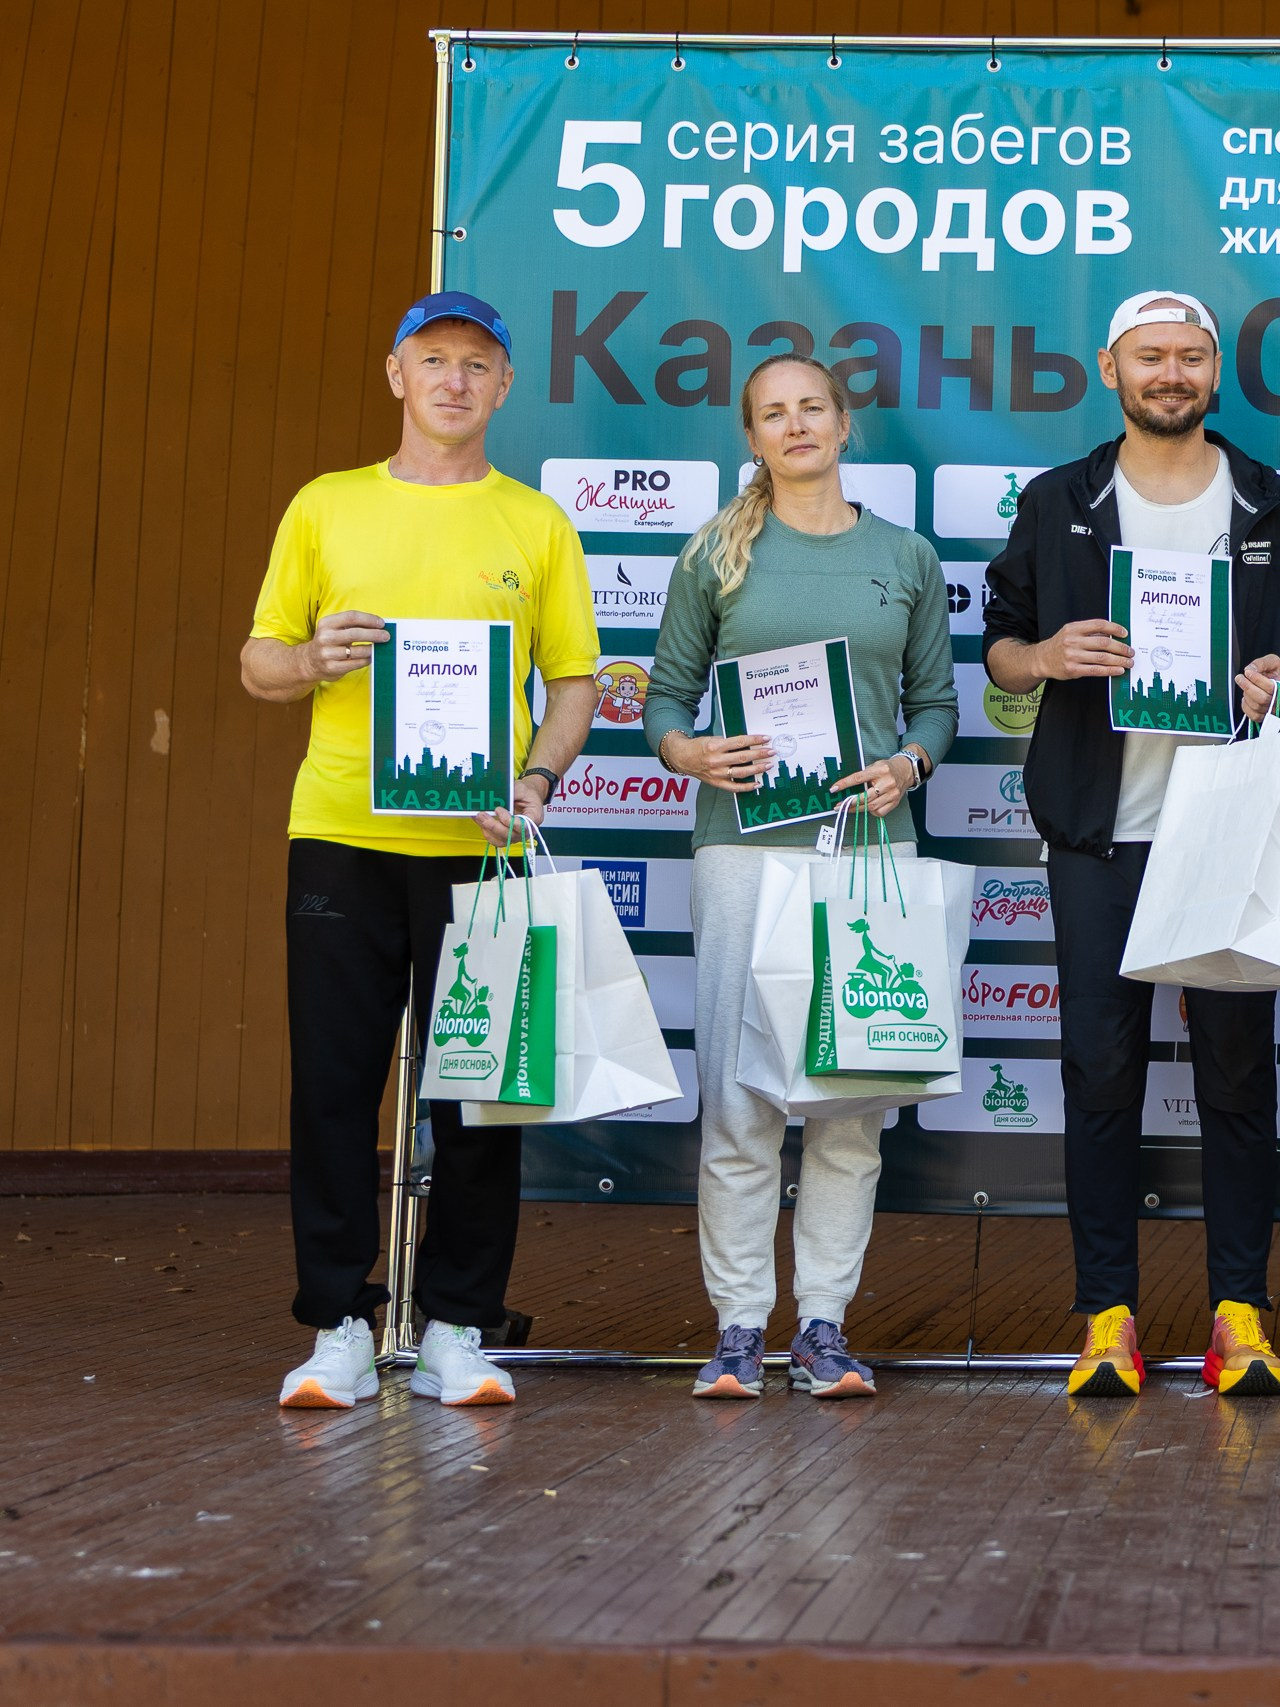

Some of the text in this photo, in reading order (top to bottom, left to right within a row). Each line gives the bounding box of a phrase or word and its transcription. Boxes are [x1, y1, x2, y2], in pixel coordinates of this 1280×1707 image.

[667, 112, 1132, 173] серия забегов
[552, 120, 646, 248] 5
[663, 183, 1133, 273] городов
[613, 469, 671, 492] PRO
[575, 477, 676, 521] Женщин
[634, 519, 675, 528] Екатеринбург
[1144, 573, 1177, 582] городов
[591, 590, 668, 606] ITTORIO
[1140, 591, 1201, 607] ДИПЛОМ
[411, 644, 449, 653] городов
[408, 663, 478, 678] ДИПЛОМ
[754, 667, 790, 679] городов
[753, 677, 819, 700] ДИПЛОМ
[989, 694, 1023, 705] верни
[1118, 708, 1228, 733] КАЗАНЬ
[380, 788, 506, 811] КАЗАНЬ
[546, 804, 689, 817] Благотворительная программа
[745, 788, 851, 827] КАЗАН
[617, 870, 640, 882] ТАРИХ
[614, 904, 639, 917] ТОРИЯ
[974, 896, 1049, 926] Казань
[844, 984, 928, 1009] bionova
[434, 1010, 490, 1035] bionova
[963, 1013, 1022, 1022] ворительная
[871, 1030, 941, 1043] ДНЯ ОСНОВА
[442, 1056, 492, 1071] ДНЯ ОСНОВА
[983, 1094, 1028, 1108] bionova
[996, 1116, 1034, 1124] ДНЯ ОСНОВА
